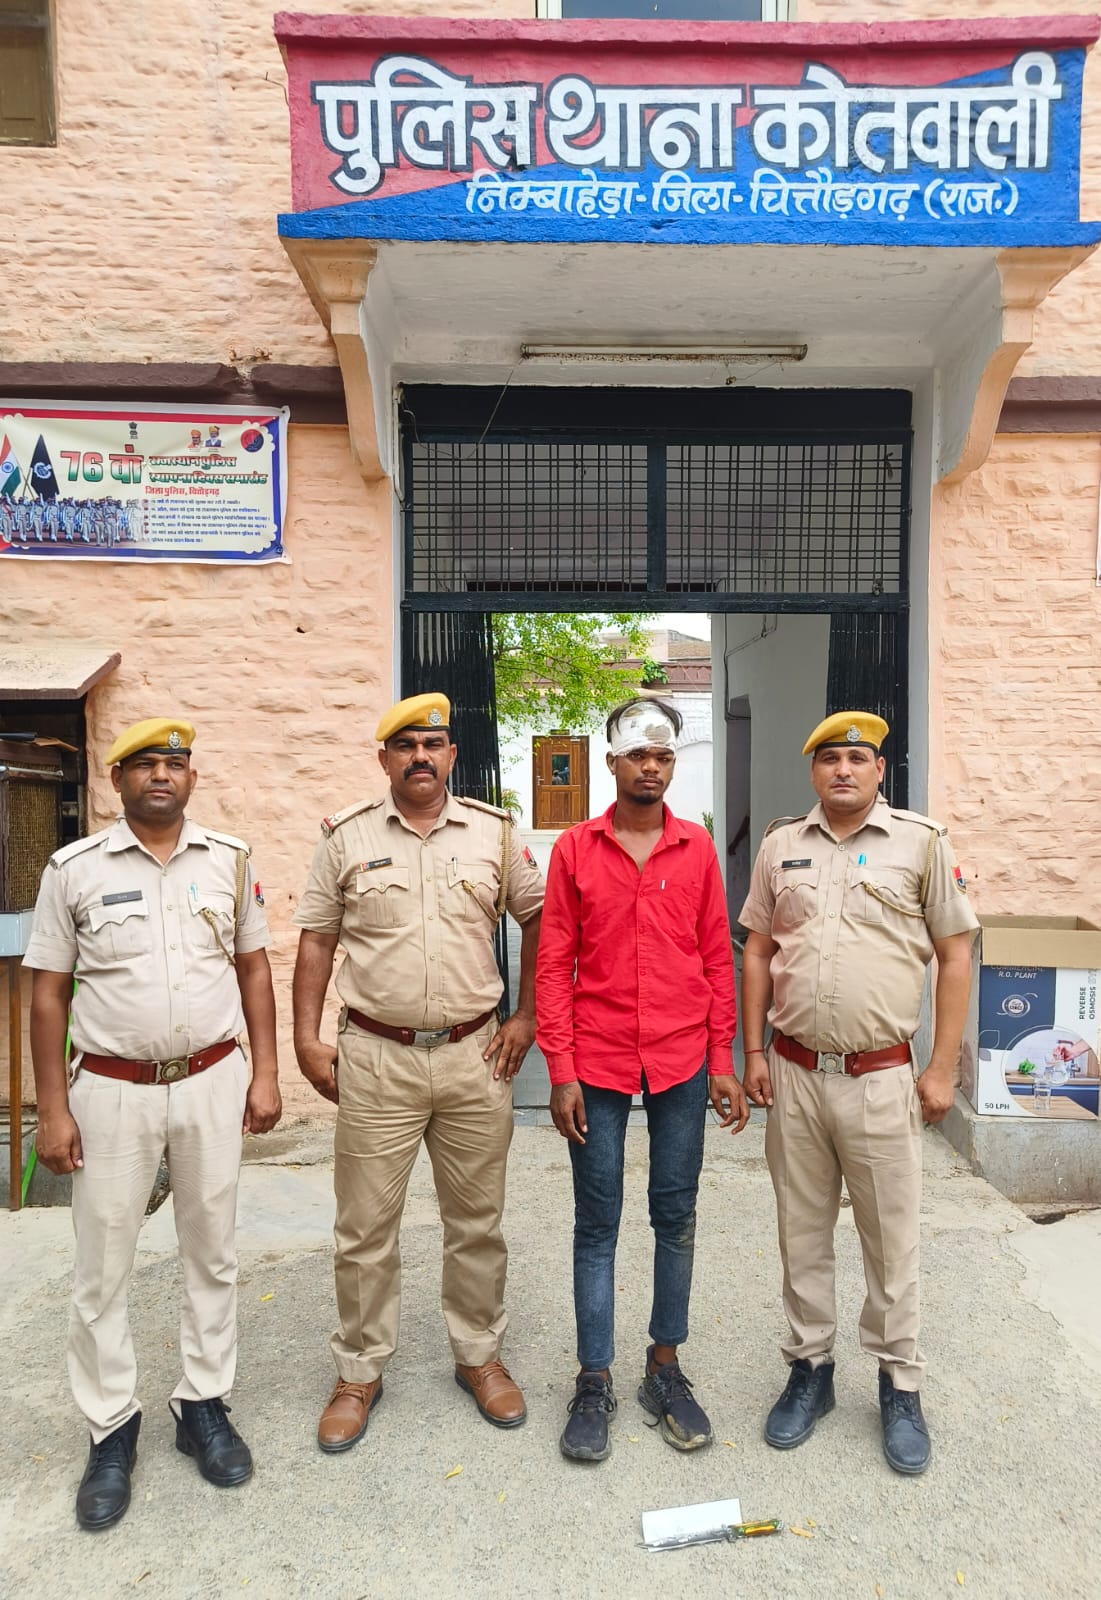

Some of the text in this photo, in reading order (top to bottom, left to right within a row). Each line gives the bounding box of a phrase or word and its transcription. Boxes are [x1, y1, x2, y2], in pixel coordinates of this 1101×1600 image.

[312, 51, 1063, 195] पुलिस थाना कोतवाली
[749, 167, 920, 222] चित्तौड़गढ़
[924, 177, 1019, 219] (राज.)
[60, 450, 104, 483] 76
[201, 454, 237, 470] पुलिस
[145, 486, 163, 495] जिला
